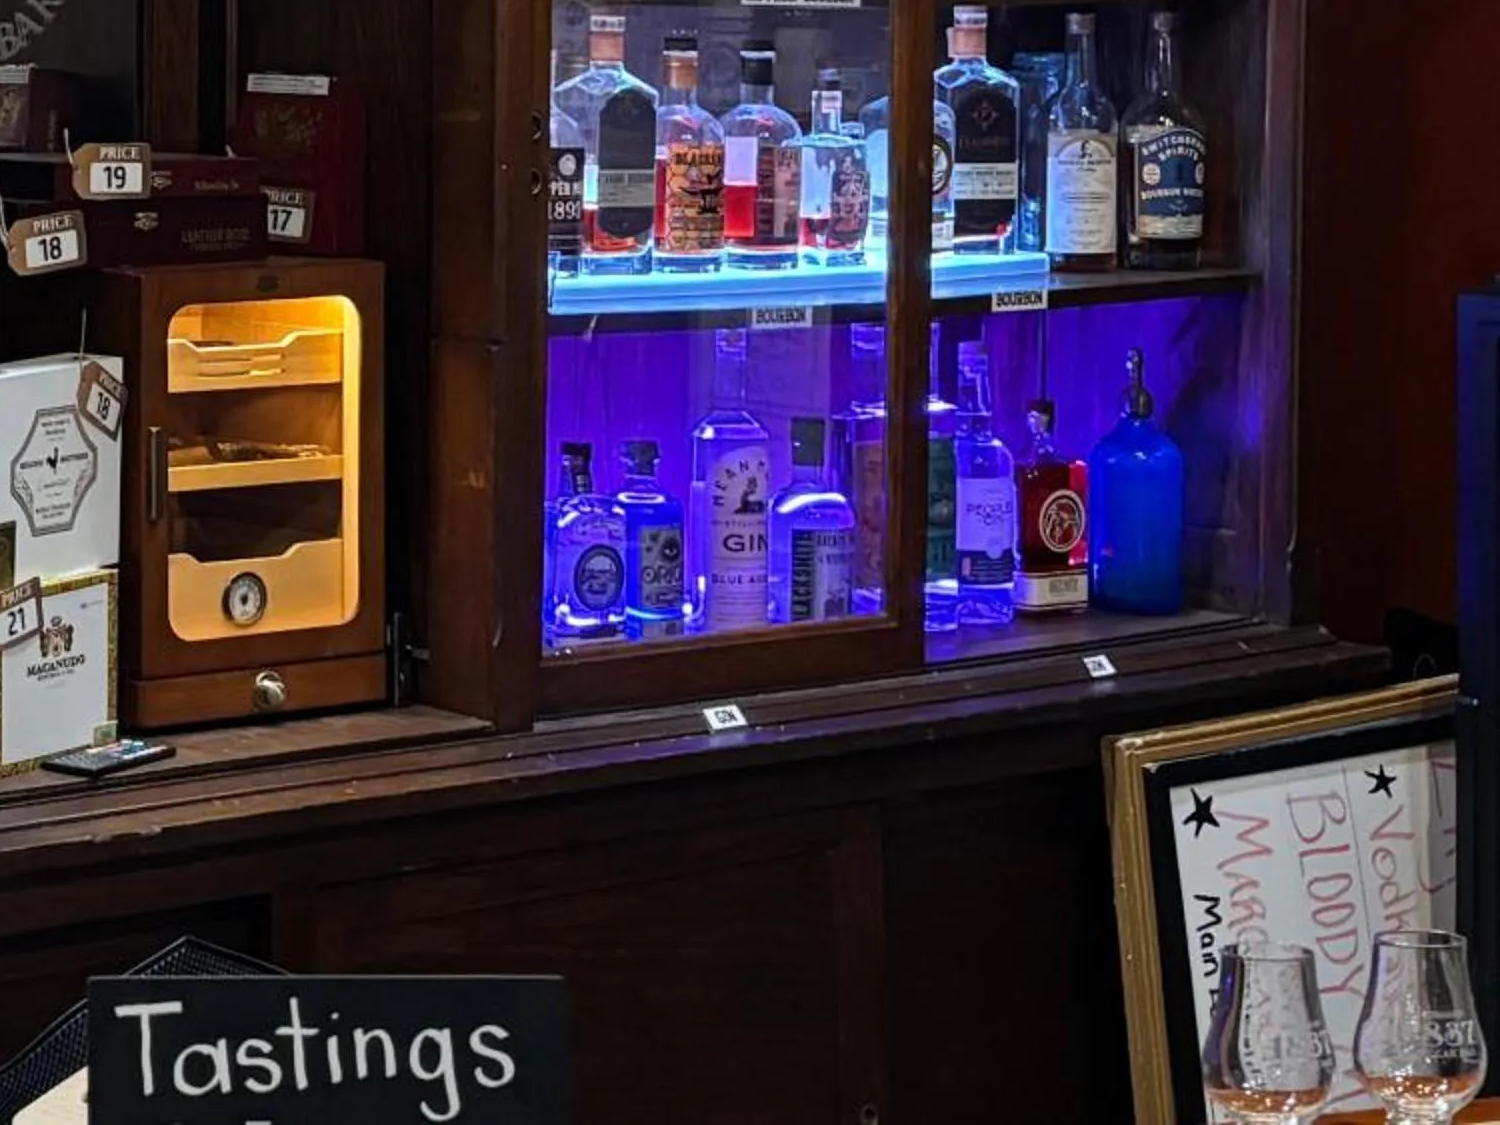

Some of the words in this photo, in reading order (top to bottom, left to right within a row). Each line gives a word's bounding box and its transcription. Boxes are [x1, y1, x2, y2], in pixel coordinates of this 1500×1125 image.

[100, 146, 141, 161] PRICE
[102, 166, 127, 190] 19
[33, 215, 73, 233] PRICE
[270, 209, 293, 232] 17
[37, 236, 63, 262] 18
[1286, 790, 1366, 997] BLOODY
[113, 996, 516, 1122] Tastings
